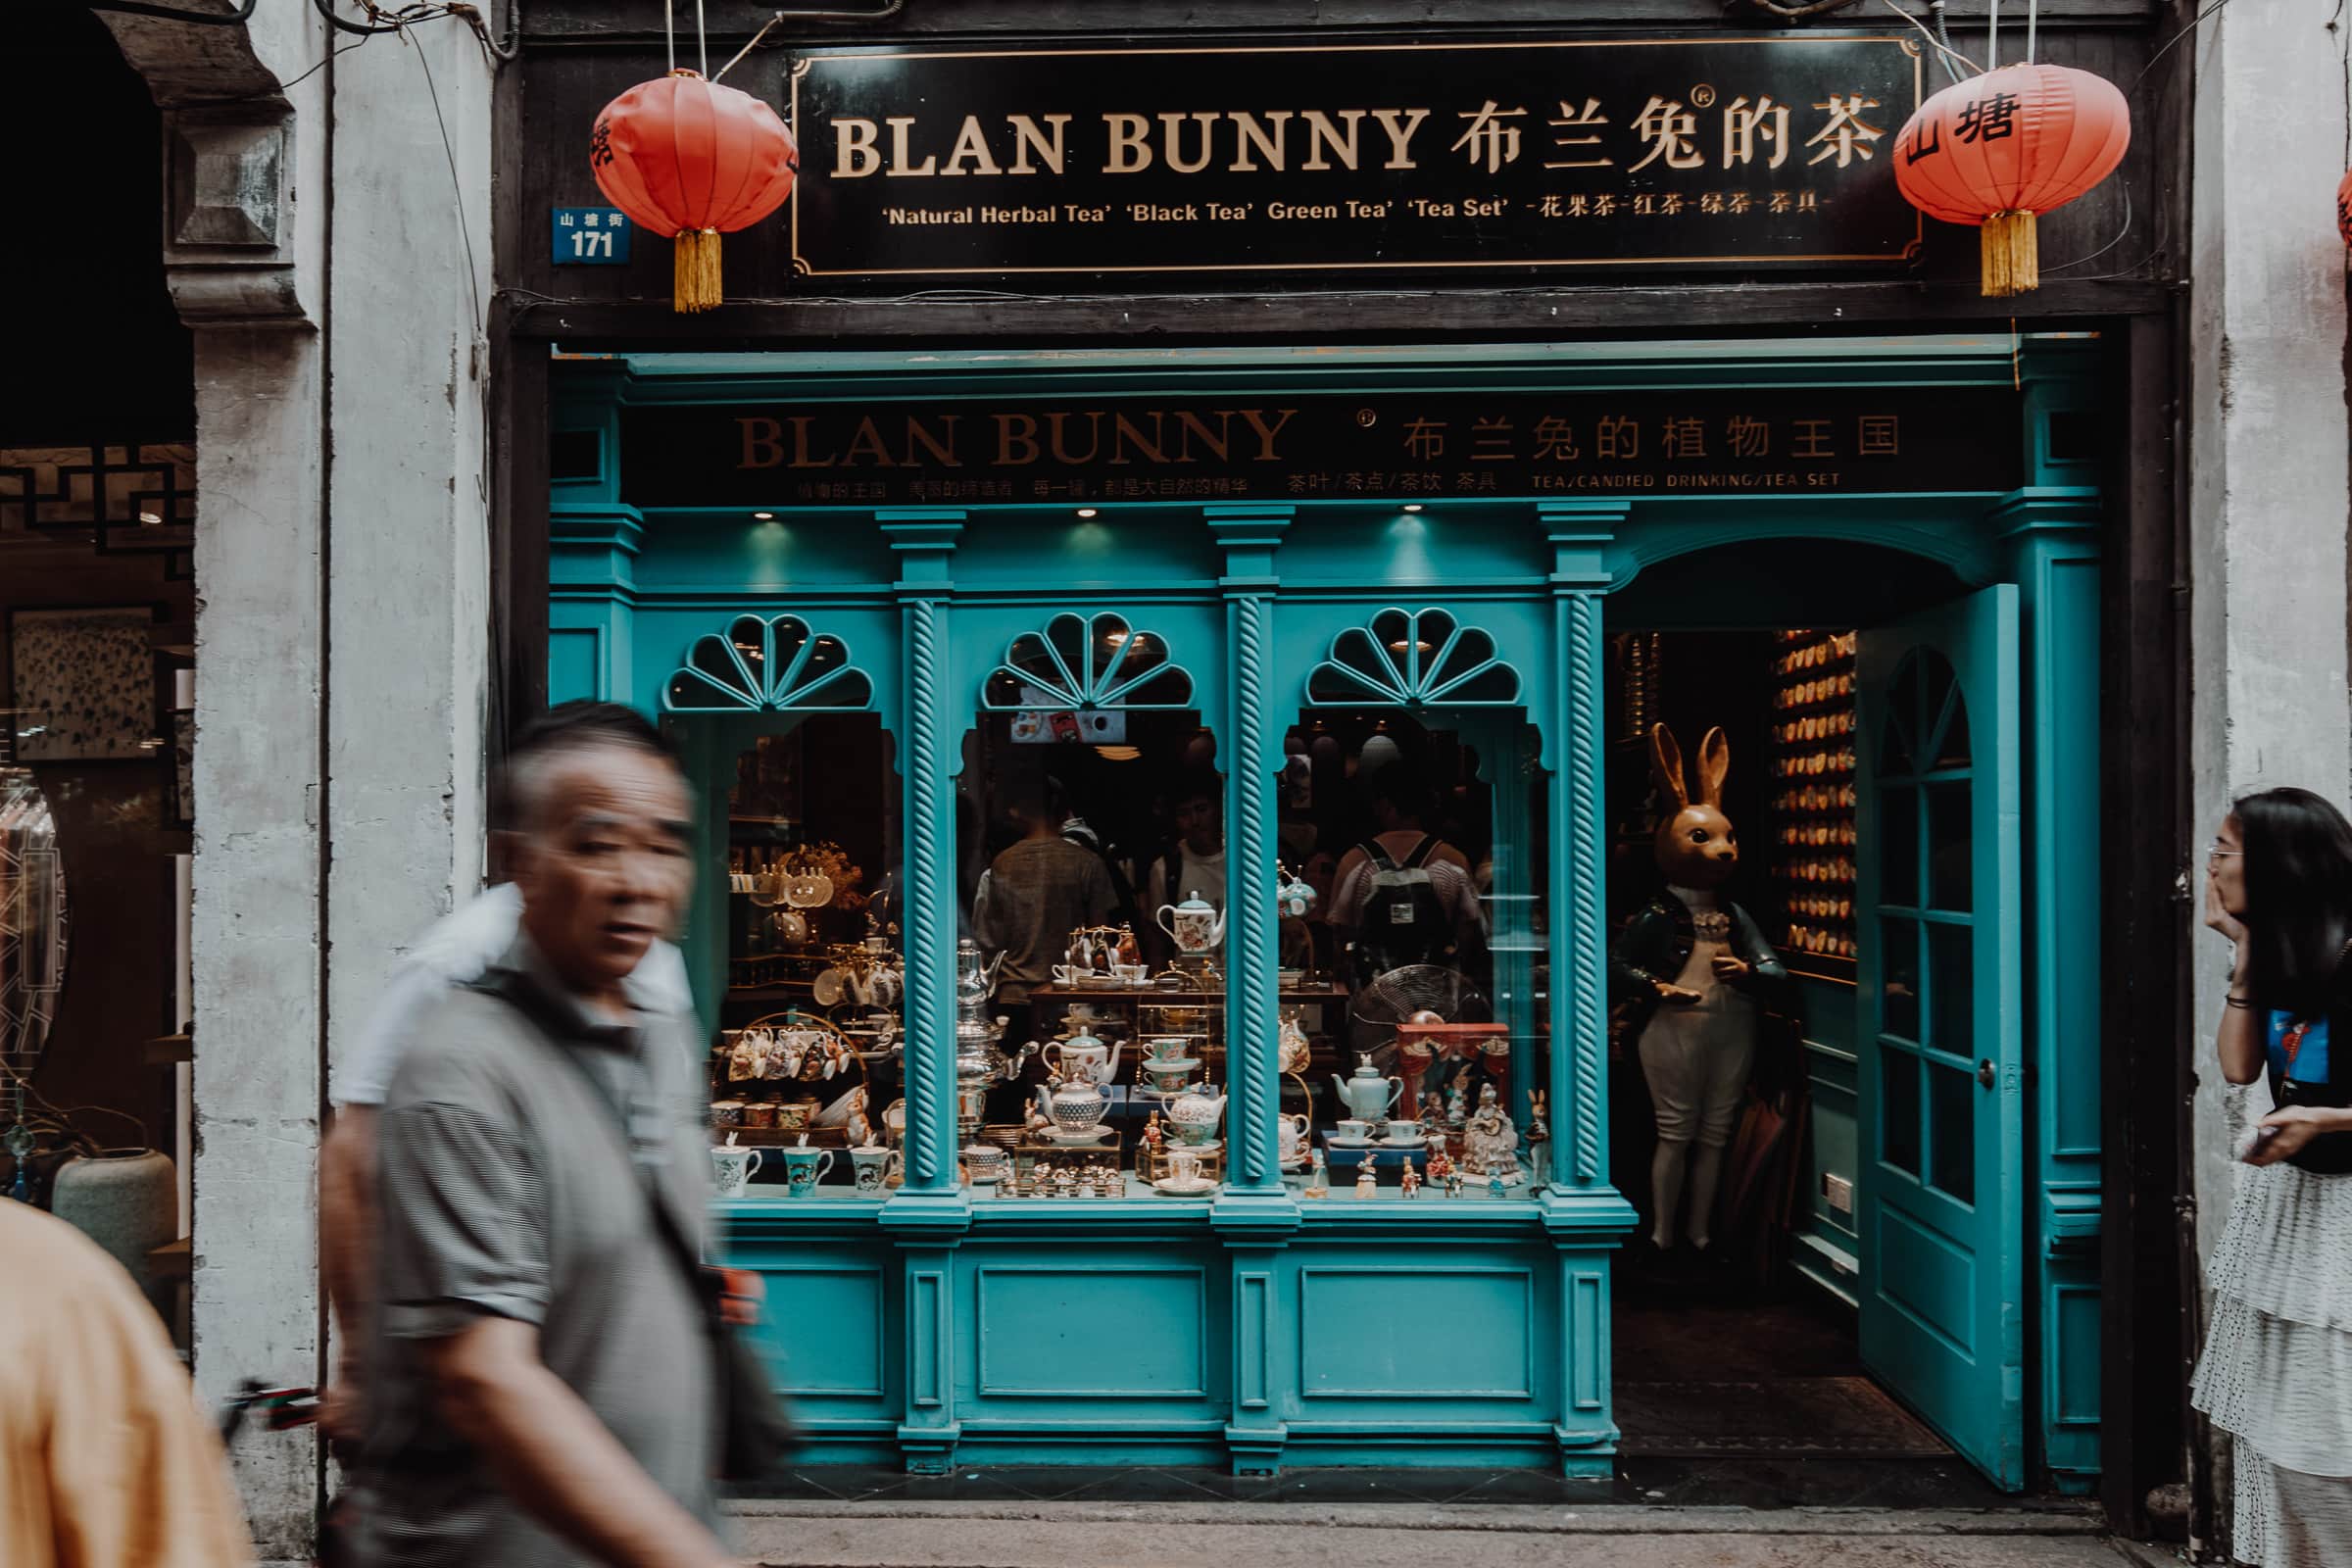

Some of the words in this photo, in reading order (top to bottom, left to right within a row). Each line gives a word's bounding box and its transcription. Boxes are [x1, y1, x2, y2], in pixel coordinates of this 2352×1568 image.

[830, 113, 1073, 178] BLAN
[1102, 108, 1432, 174] BUNNY
[1450, 92, 1887, 174] 布兰兔的茶
[560, 213, 623, 226] 山塘街
[981, 204, 1056, 223] Herbal
[1267, 202, 1338, 220] Green
[571, 230, 612, 257] 171
[735, 415, 963, 469] BLAN
[992, 410, 1298, 466] BUNNY
[1402, 414, 1899, 462] 布兰兔的植物王国
[1807, 471, 1840, 487] SET
